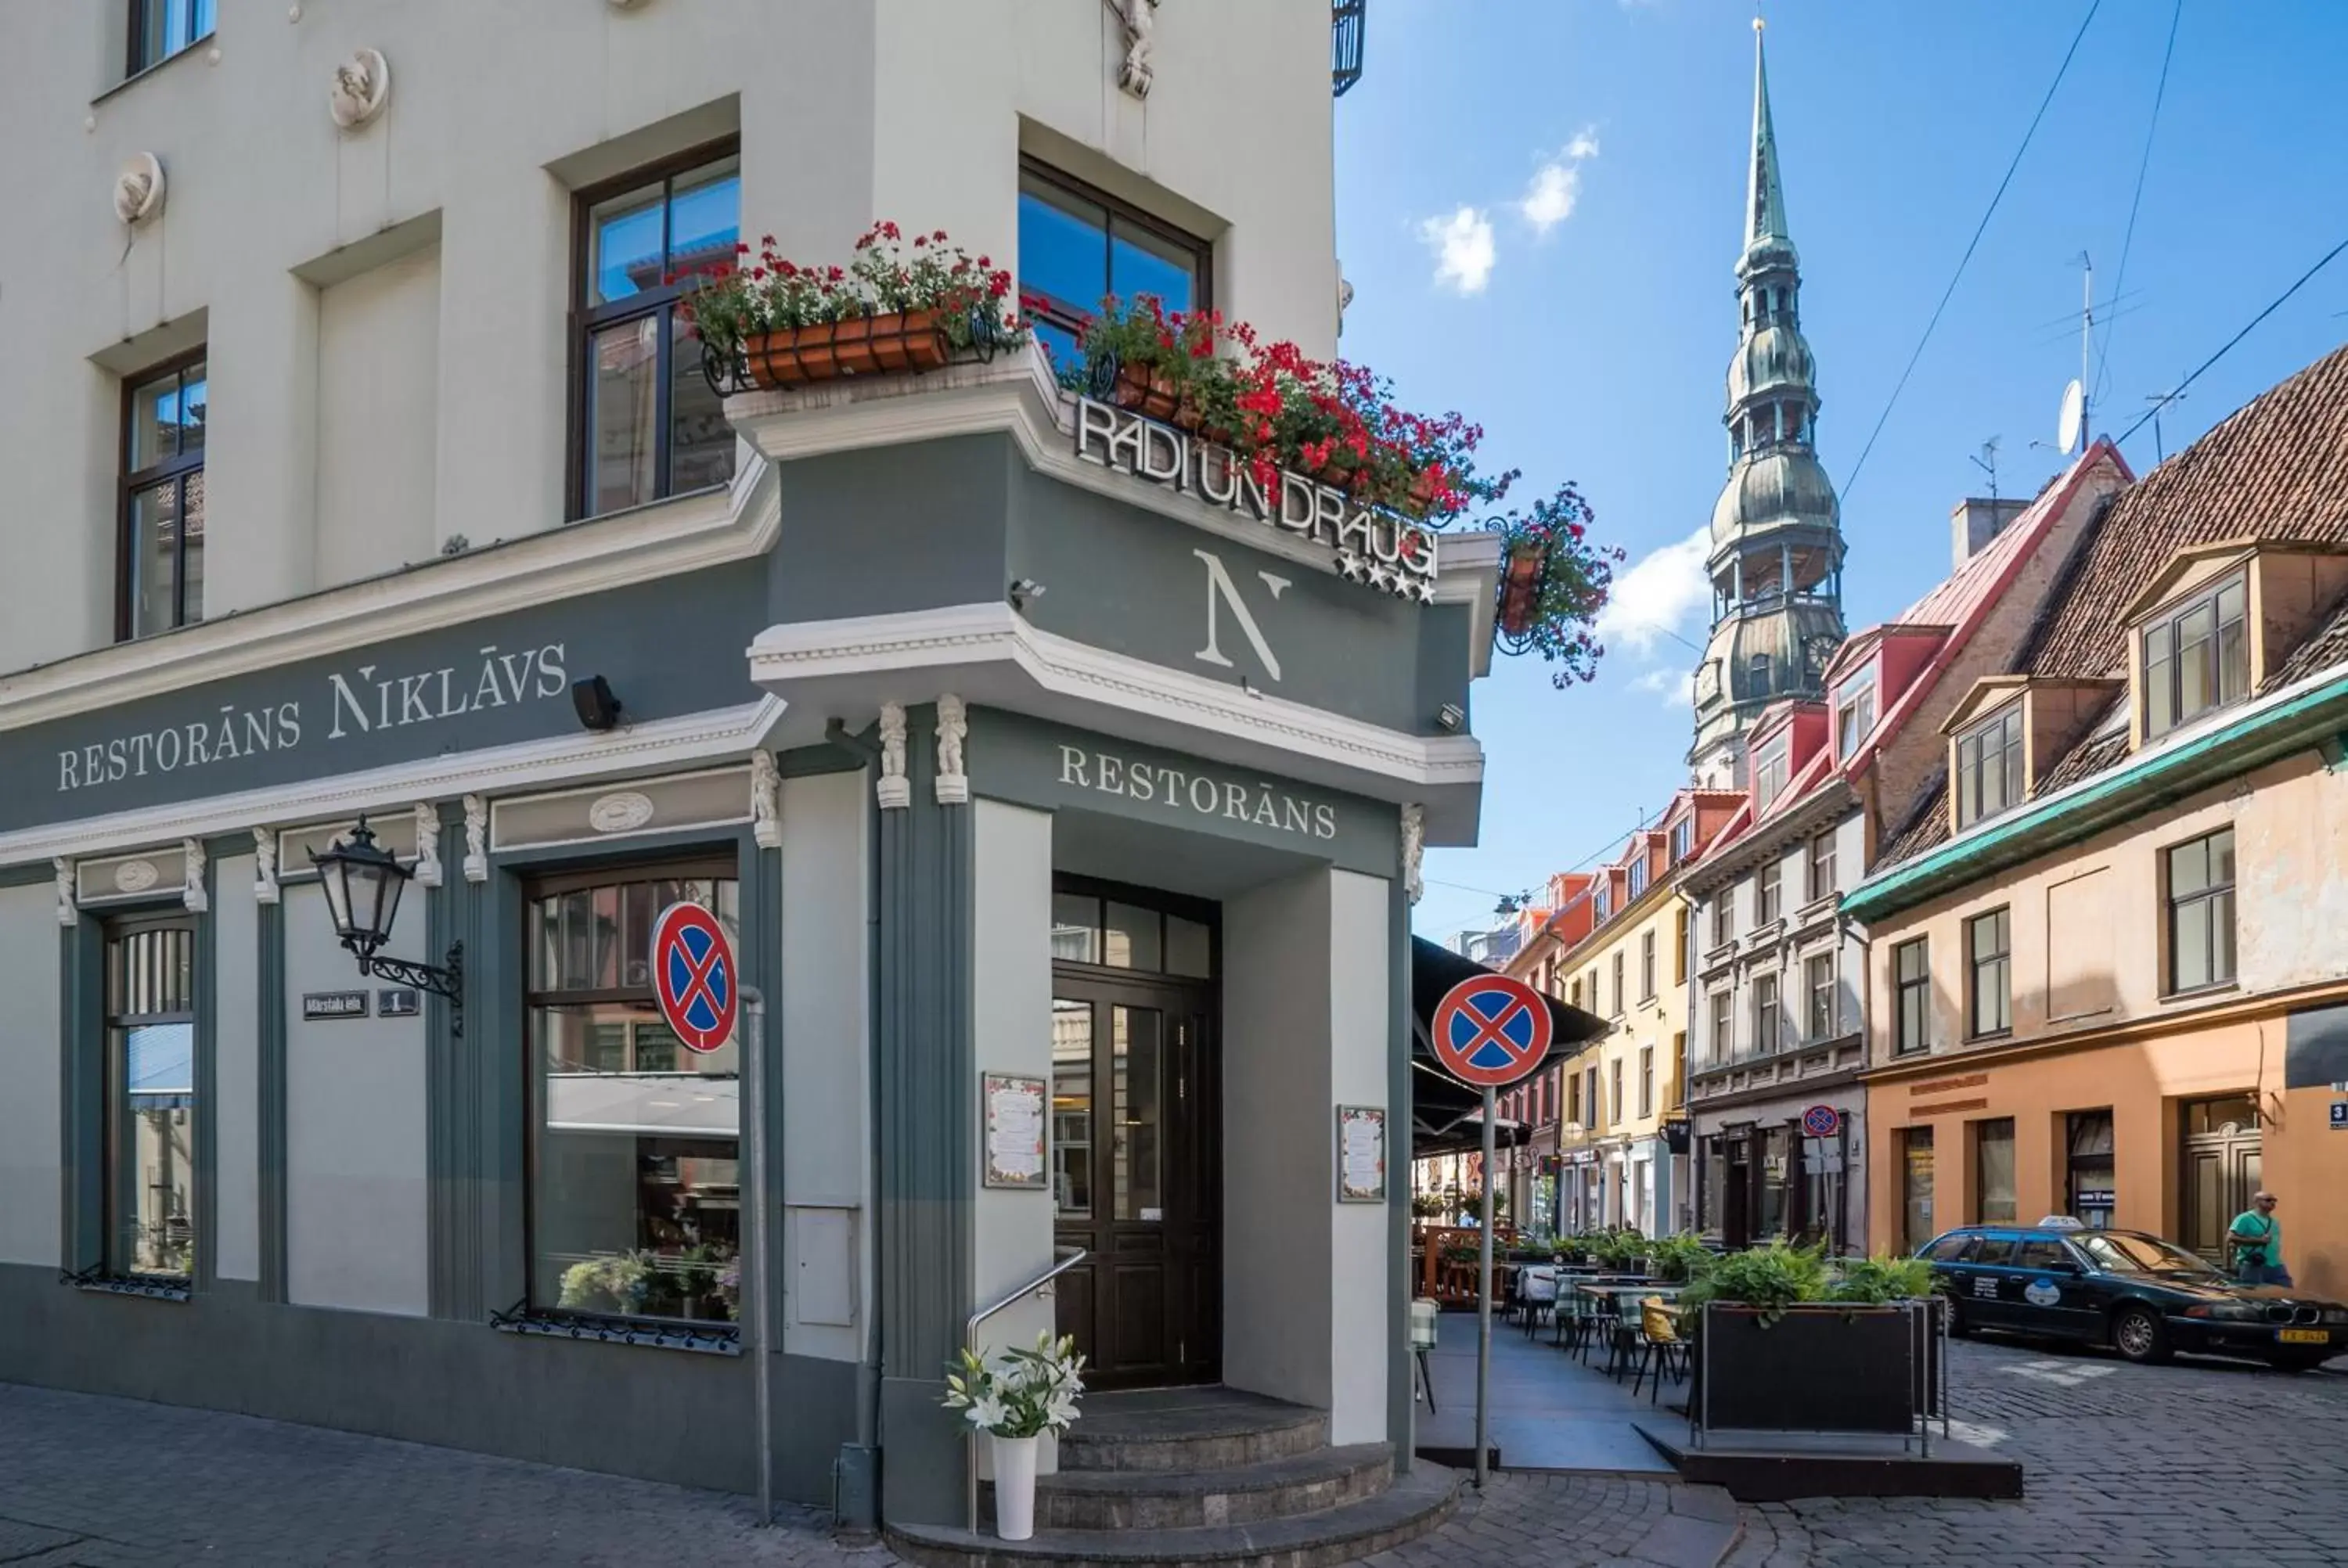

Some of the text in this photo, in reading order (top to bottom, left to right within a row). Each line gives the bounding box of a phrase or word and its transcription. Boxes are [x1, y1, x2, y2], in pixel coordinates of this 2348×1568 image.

[1079, 398, 1439, 579] RADI UN DRAUGI
[1193, 548, 1292, 682] N
[57, 701, 301, 792] RESTORĀNS
[1058, 745, 1337, 840] RESTORĀNS
[391, 992, 402, 1012] 1
[2333, 1106, 2343, 1119] 3
